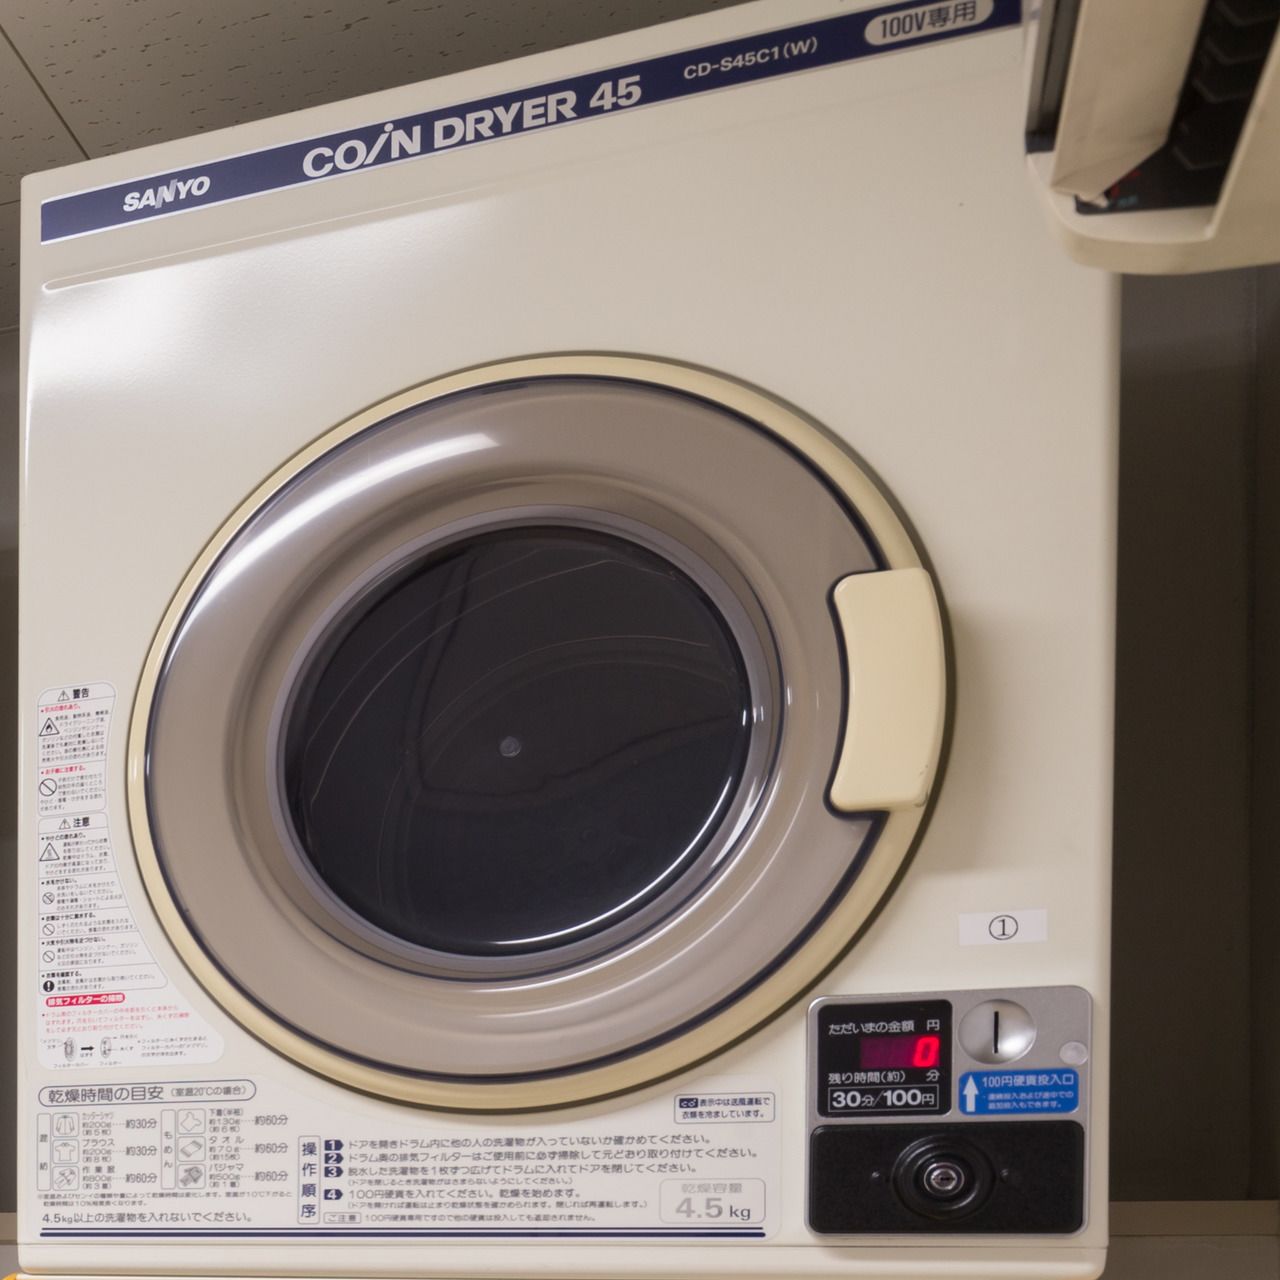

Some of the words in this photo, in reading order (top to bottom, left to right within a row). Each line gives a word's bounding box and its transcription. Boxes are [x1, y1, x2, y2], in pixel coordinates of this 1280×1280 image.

[123, 175, 210, 213] SANYO
[433, 89, 577, 154] DRYER
[589, 76, 642, 112] 45
[682, 35, 819, 81] CD-S45C1(W)
[879, 0, 978, 40] 100V専用
[72, 688, 90, 700] 警告
[73, 816, 90, 828] 注意
[828, 1021, 915, 1035] ただいまの金額
[927, 1019, 939, 1031] 円
[913, 1036, 939, 1067] 0
[926, 1070, 940, 1082] 分
[982, 1074, 1074, 1088] 100円硬貨投入口
[48, 1086, 164, 1104] 乾燥時間の目安
[832, 1089, 935, 1107] 30分/100円
[328, 1140, 336, 1150] 1
[328, 1153, 337, 1164] 2
[209, 1163, 244, 1171] パジャマ
[328, 1167, 337, 1177] 3
[301, 1141, 317, 1218] 操作順序
[327, 1189, 337, 1200] 4
[675, 1198, 723, 1219] 4.5
[729, 1205, 751, 1220] kg
[42, 1212, 252, 1224] 4.5kg以上の洗濯物を入れないでください。
